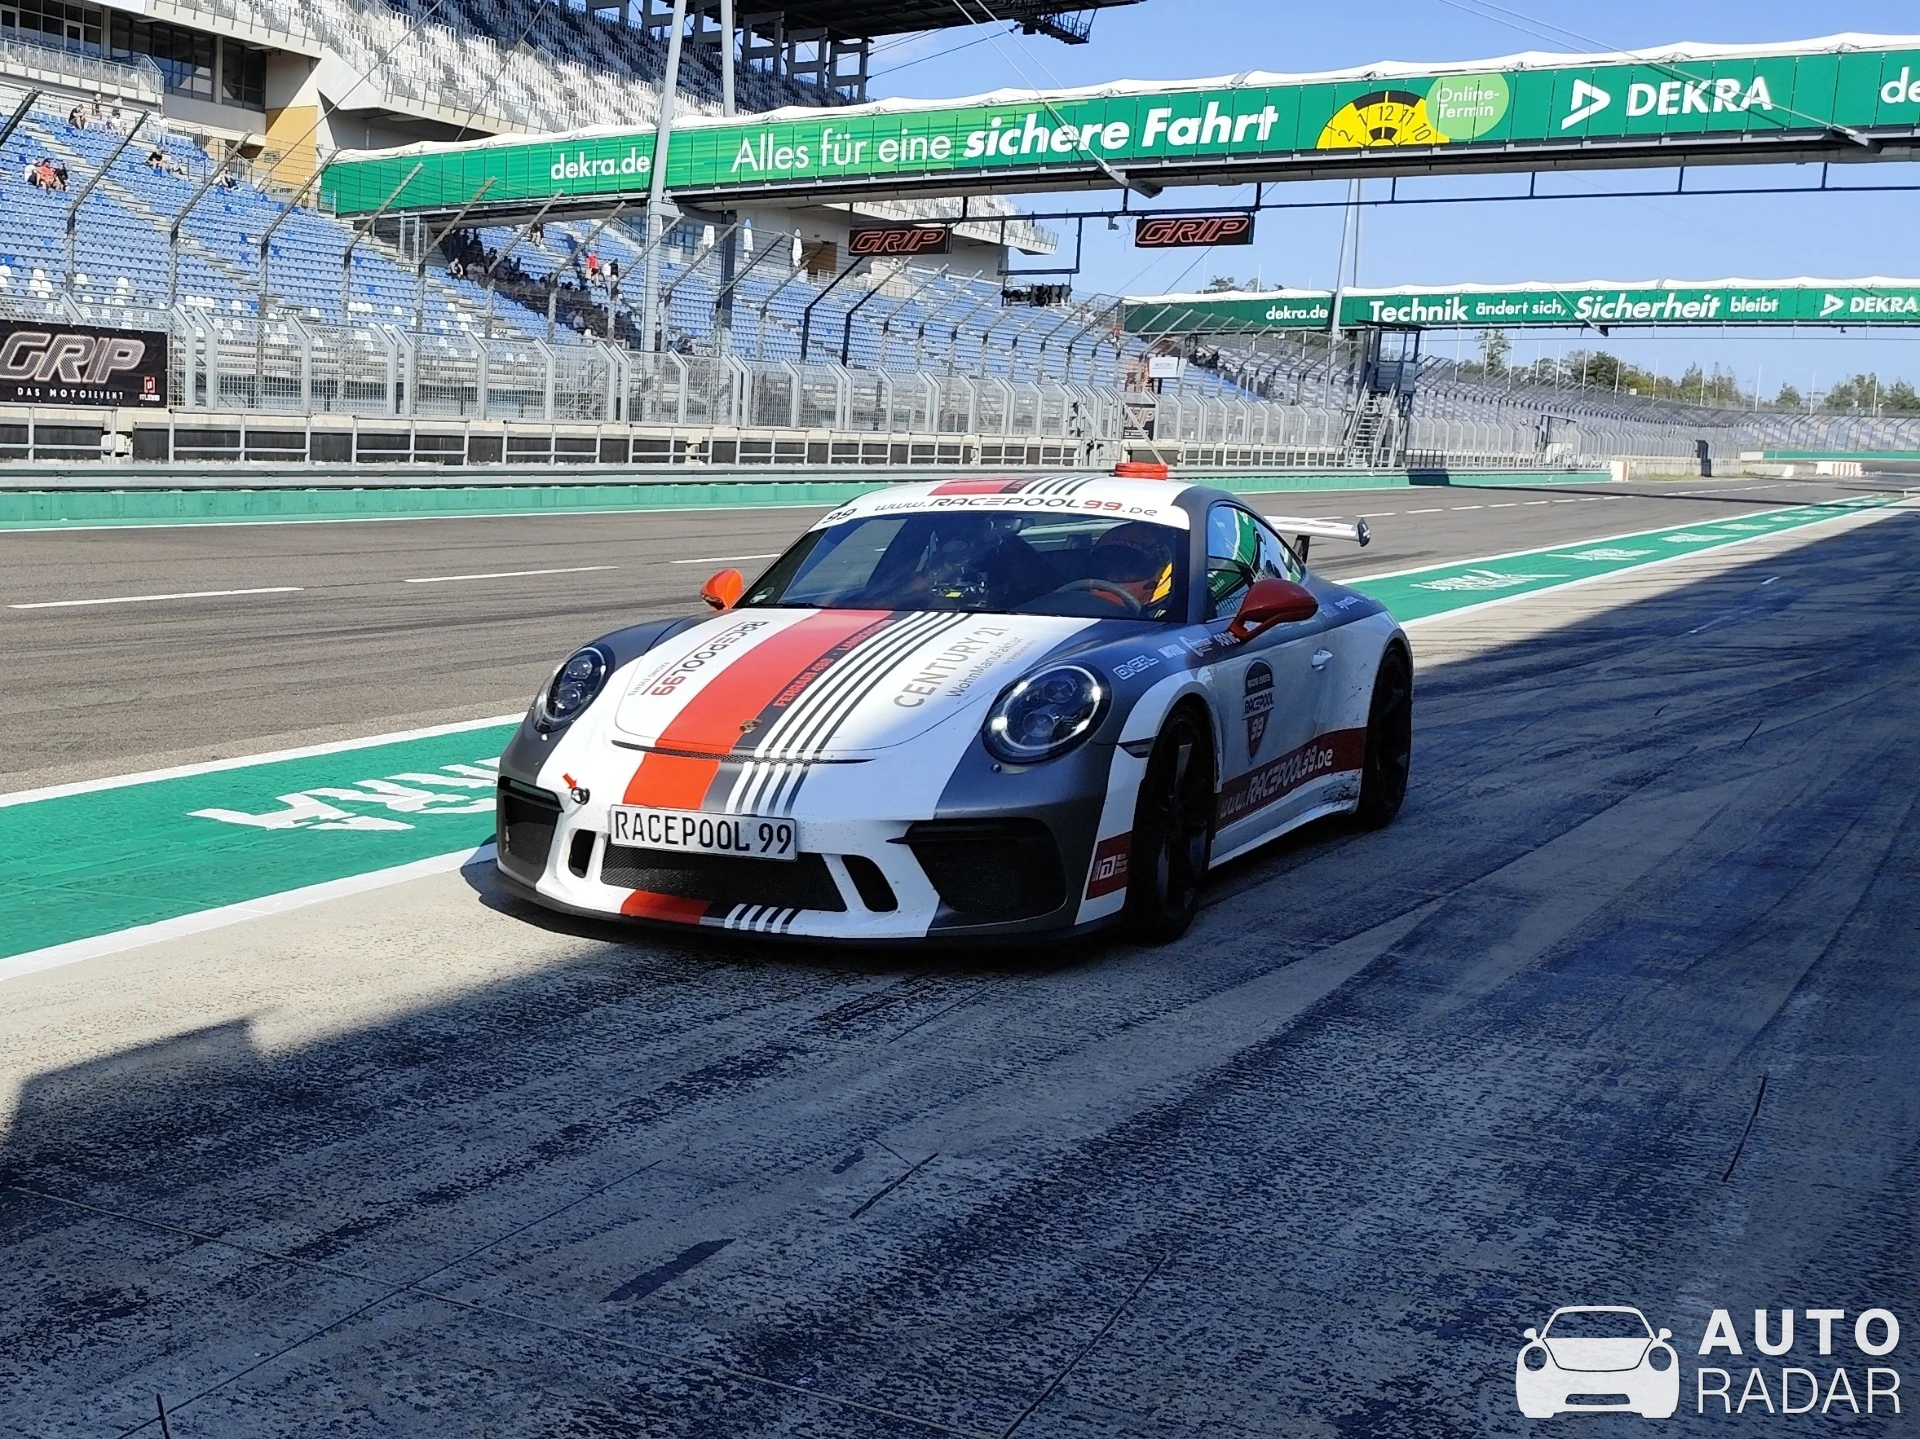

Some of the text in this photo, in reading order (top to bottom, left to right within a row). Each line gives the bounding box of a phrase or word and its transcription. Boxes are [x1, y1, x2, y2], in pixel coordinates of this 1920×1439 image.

[1436, 86, 1499, 102] Online-
[1626, 76, 1773, 117] DEKRA
[1379, 105, 1394, 121] 12
[1398, 109, 1415, 127] 11
[1439, 103, 1494, 118] Termin
[730, 101, 1279, 173] Alles für eine sichere Fahrt
[1338, 129, 1354, 142] 2
[1412, 123, 1431, 141] 10
[551, 147, 651, 180] dekra.de
[850, 229, 946, 254] GRIP
[1136, 217, 1250, 244] GRIP
[1265, 304, 1328, 320] dekra.de
[1369, 293, 1779, 323] Technik ändert sich, Sicherheit bleibt
[1850, 296, 1918, 313] DEKRA
[0, 331, 146, 384] GRIP
[17, 387, 40, 397] DAS
[822, 508, 857, 524] 99
[650, 621, 770, 696] RACEPOOL99
[893, 636, 990, 708] CENTURY
[1250, 716, 1265, 741] 99
[615, 811, 792, 855] RACEPOOL 99
